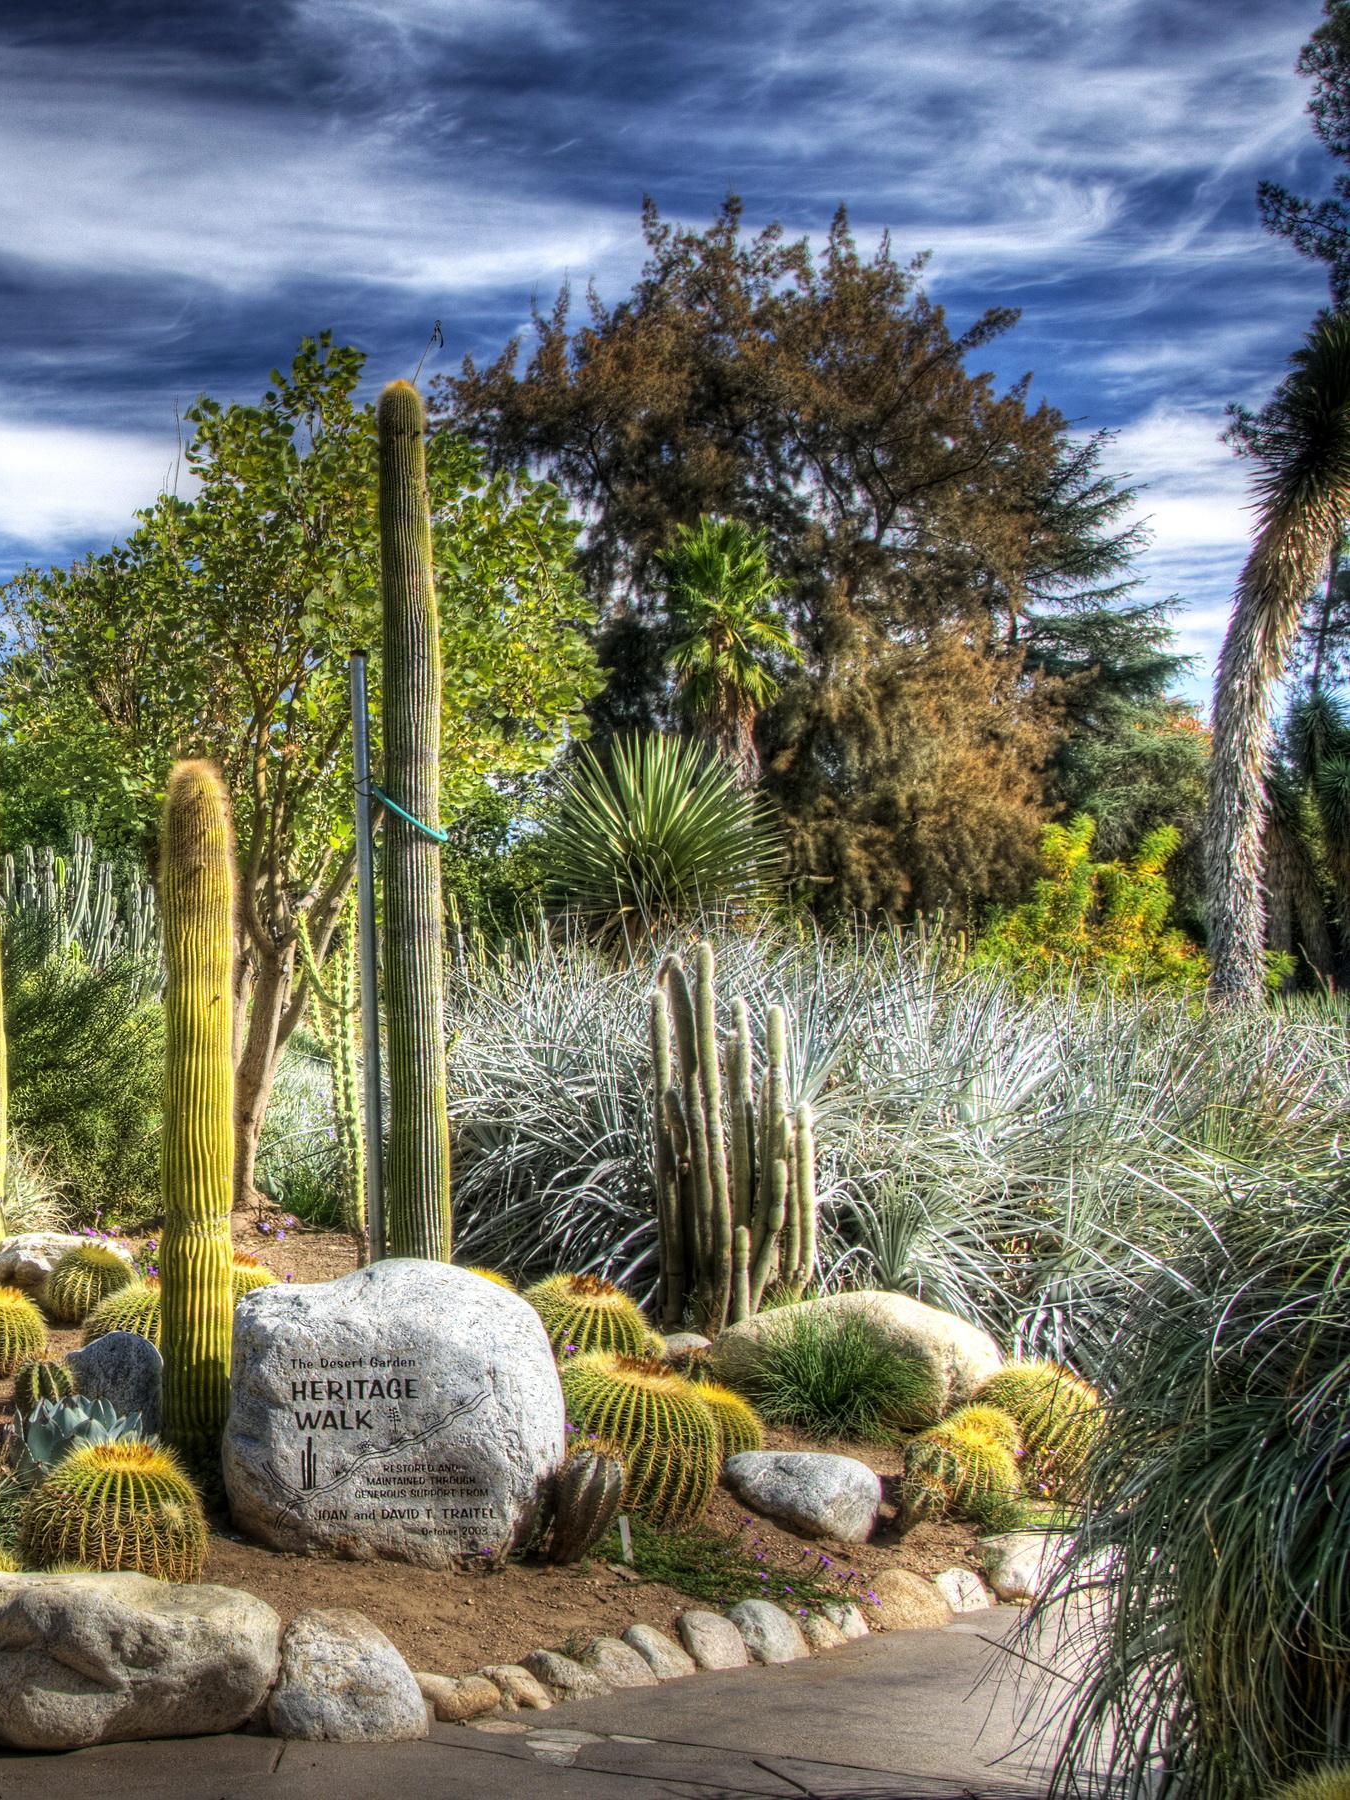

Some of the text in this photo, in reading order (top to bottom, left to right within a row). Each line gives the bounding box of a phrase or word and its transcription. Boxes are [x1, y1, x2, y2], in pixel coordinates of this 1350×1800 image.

[291, 1357, 415, 1369] The Desert Garden
[291, 1379, 419, 1401] HERITAGE
[295, 1410, 373, 1430] WALK
[383, 1464, 458, 1473] RESTORED AND
[367, 1476, 476, 1486] MAINTAINED THROUGH
[355, 1489, 489, 1499] GENEROUS SUPPORT FROM
[314, 1510, 347, 1521] JOAN
[354, 1510, 375, 1520] and
[382, 1509, 419, 1520] DAVID
[441, 1508, 498, 1519] TRAITEL
[421, 1528, 458, 1536] October
